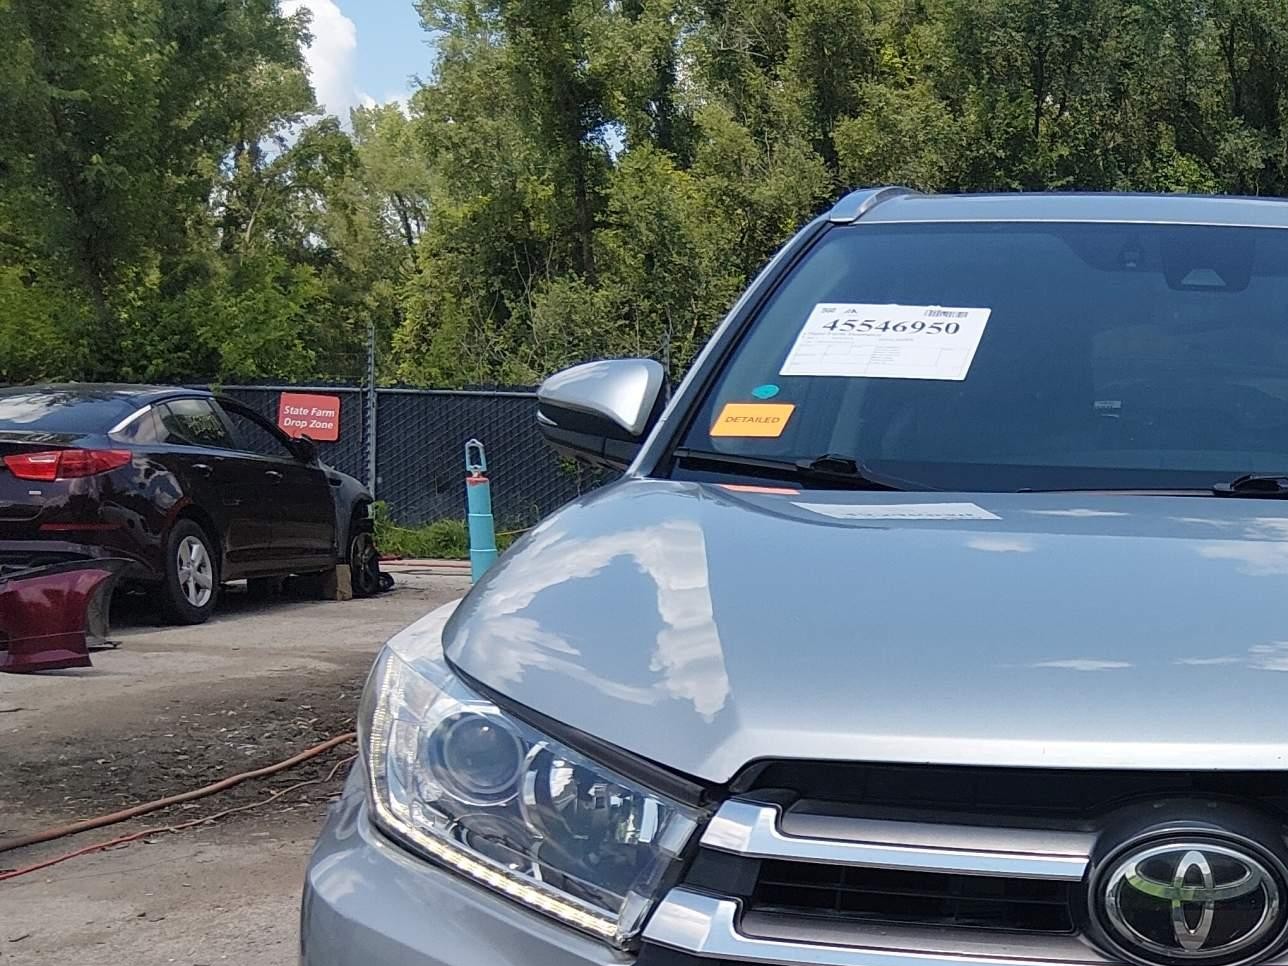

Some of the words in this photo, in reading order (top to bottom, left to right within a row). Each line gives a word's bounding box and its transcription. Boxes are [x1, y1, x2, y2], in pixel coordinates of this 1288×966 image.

[821, 318, 961, 335] 45546950
[283, 405, 309, 416] State
[310, 407, 335, 417] Farm
[283, 417, 308, 429] Drop
[309, 419, 334, 429] Zone
[724, 416, 781, 424] DETAILED
